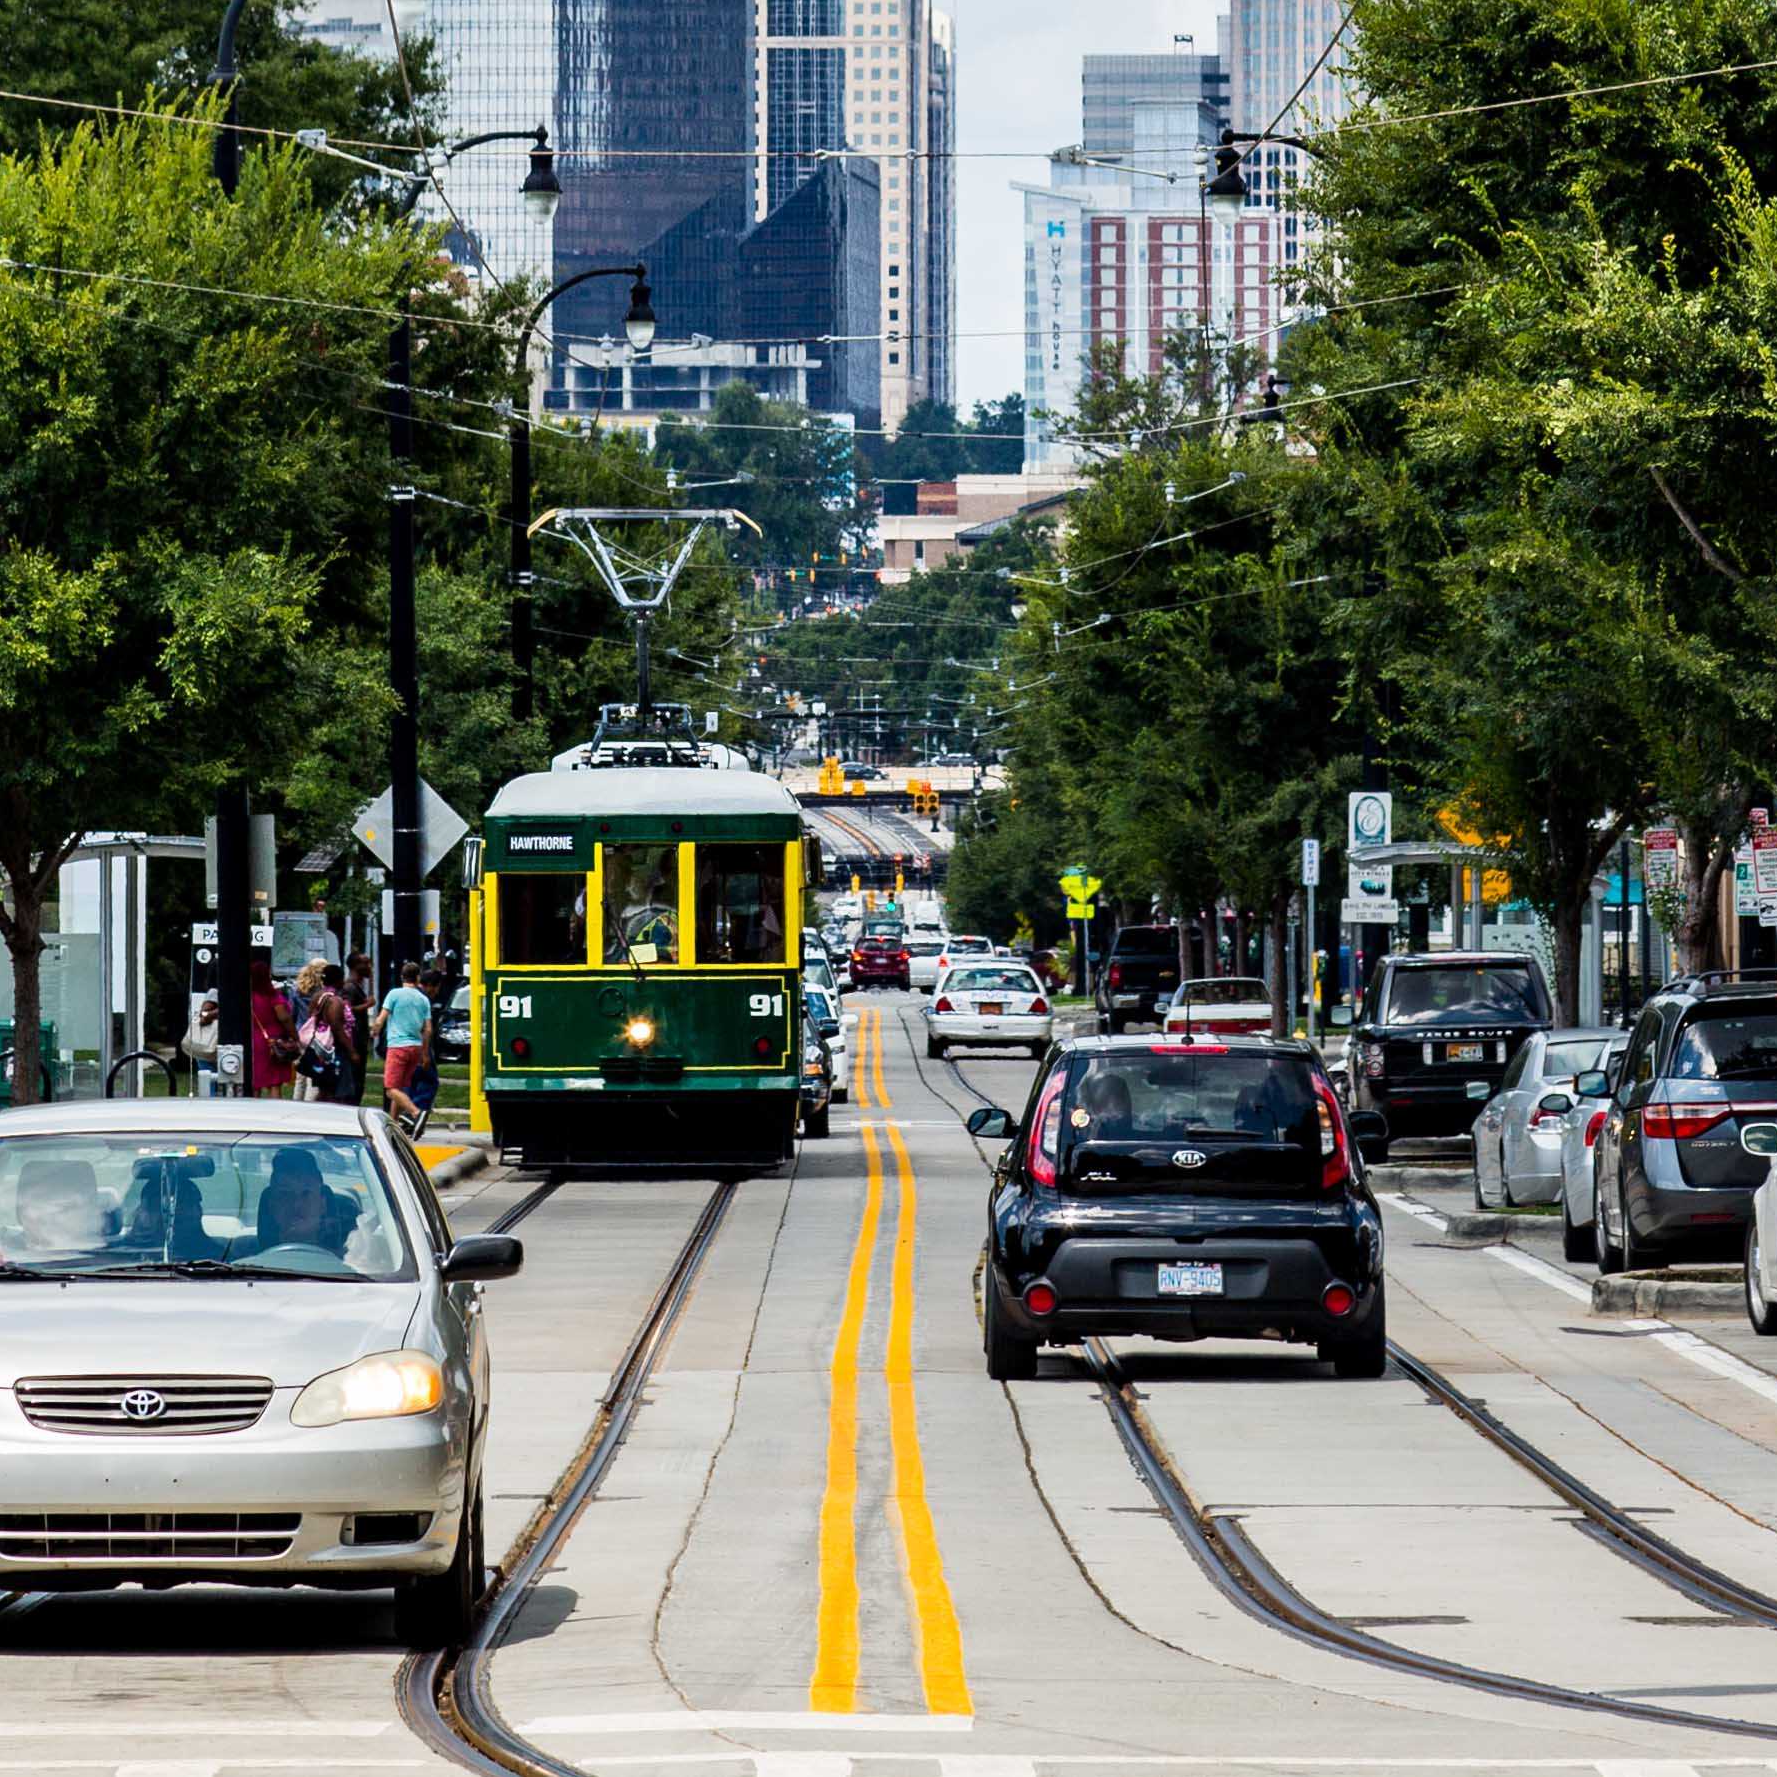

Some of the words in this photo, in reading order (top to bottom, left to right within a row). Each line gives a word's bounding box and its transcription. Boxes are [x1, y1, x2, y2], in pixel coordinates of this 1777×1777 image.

[1051, 245, 1062, 314] HYATT
[510, 836, 573, 850] HAWTHORNE
[499, 995, 533, 1019] 91
[749, 994, 783, 1018] 91
[1177, 1153, 1201, 1164] KIA
